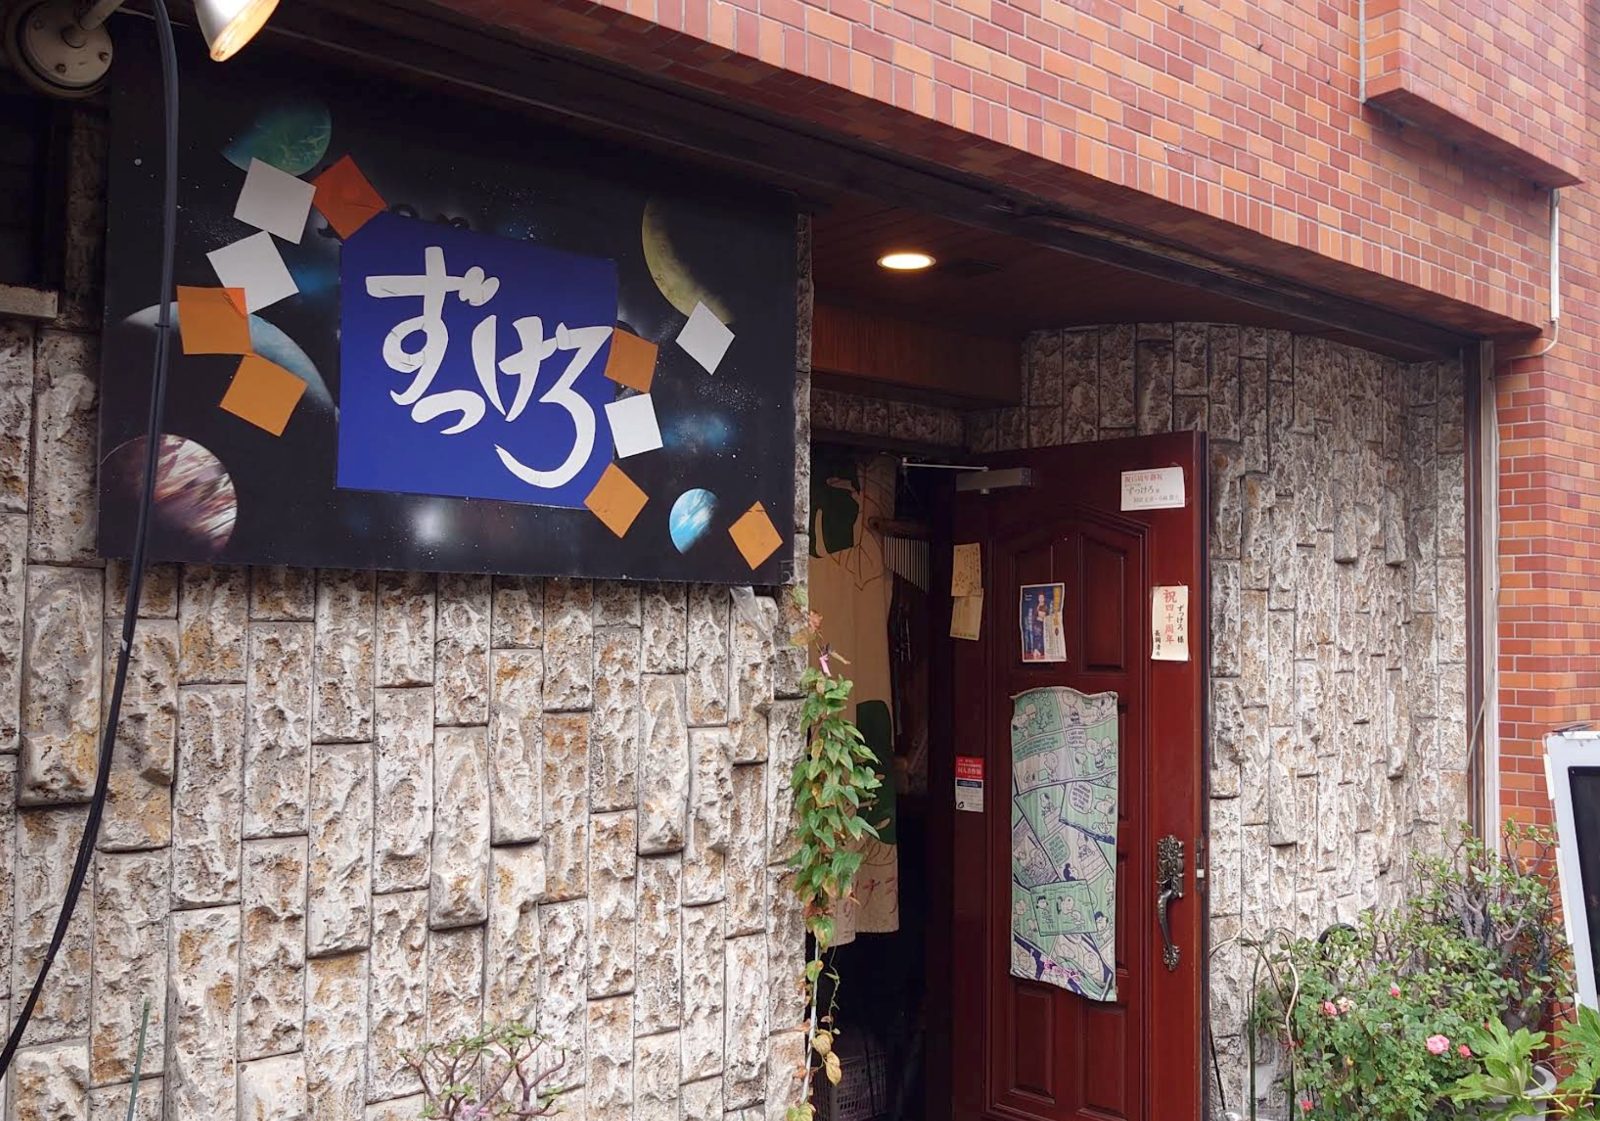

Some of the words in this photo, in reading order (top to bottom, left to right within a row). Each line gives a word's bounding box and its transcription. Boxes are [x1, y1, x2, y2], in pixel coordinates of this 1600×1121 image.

[365, 245, 613, 489] ずっけろ
[1163, 589, 1177, 645] 祝四十周年
